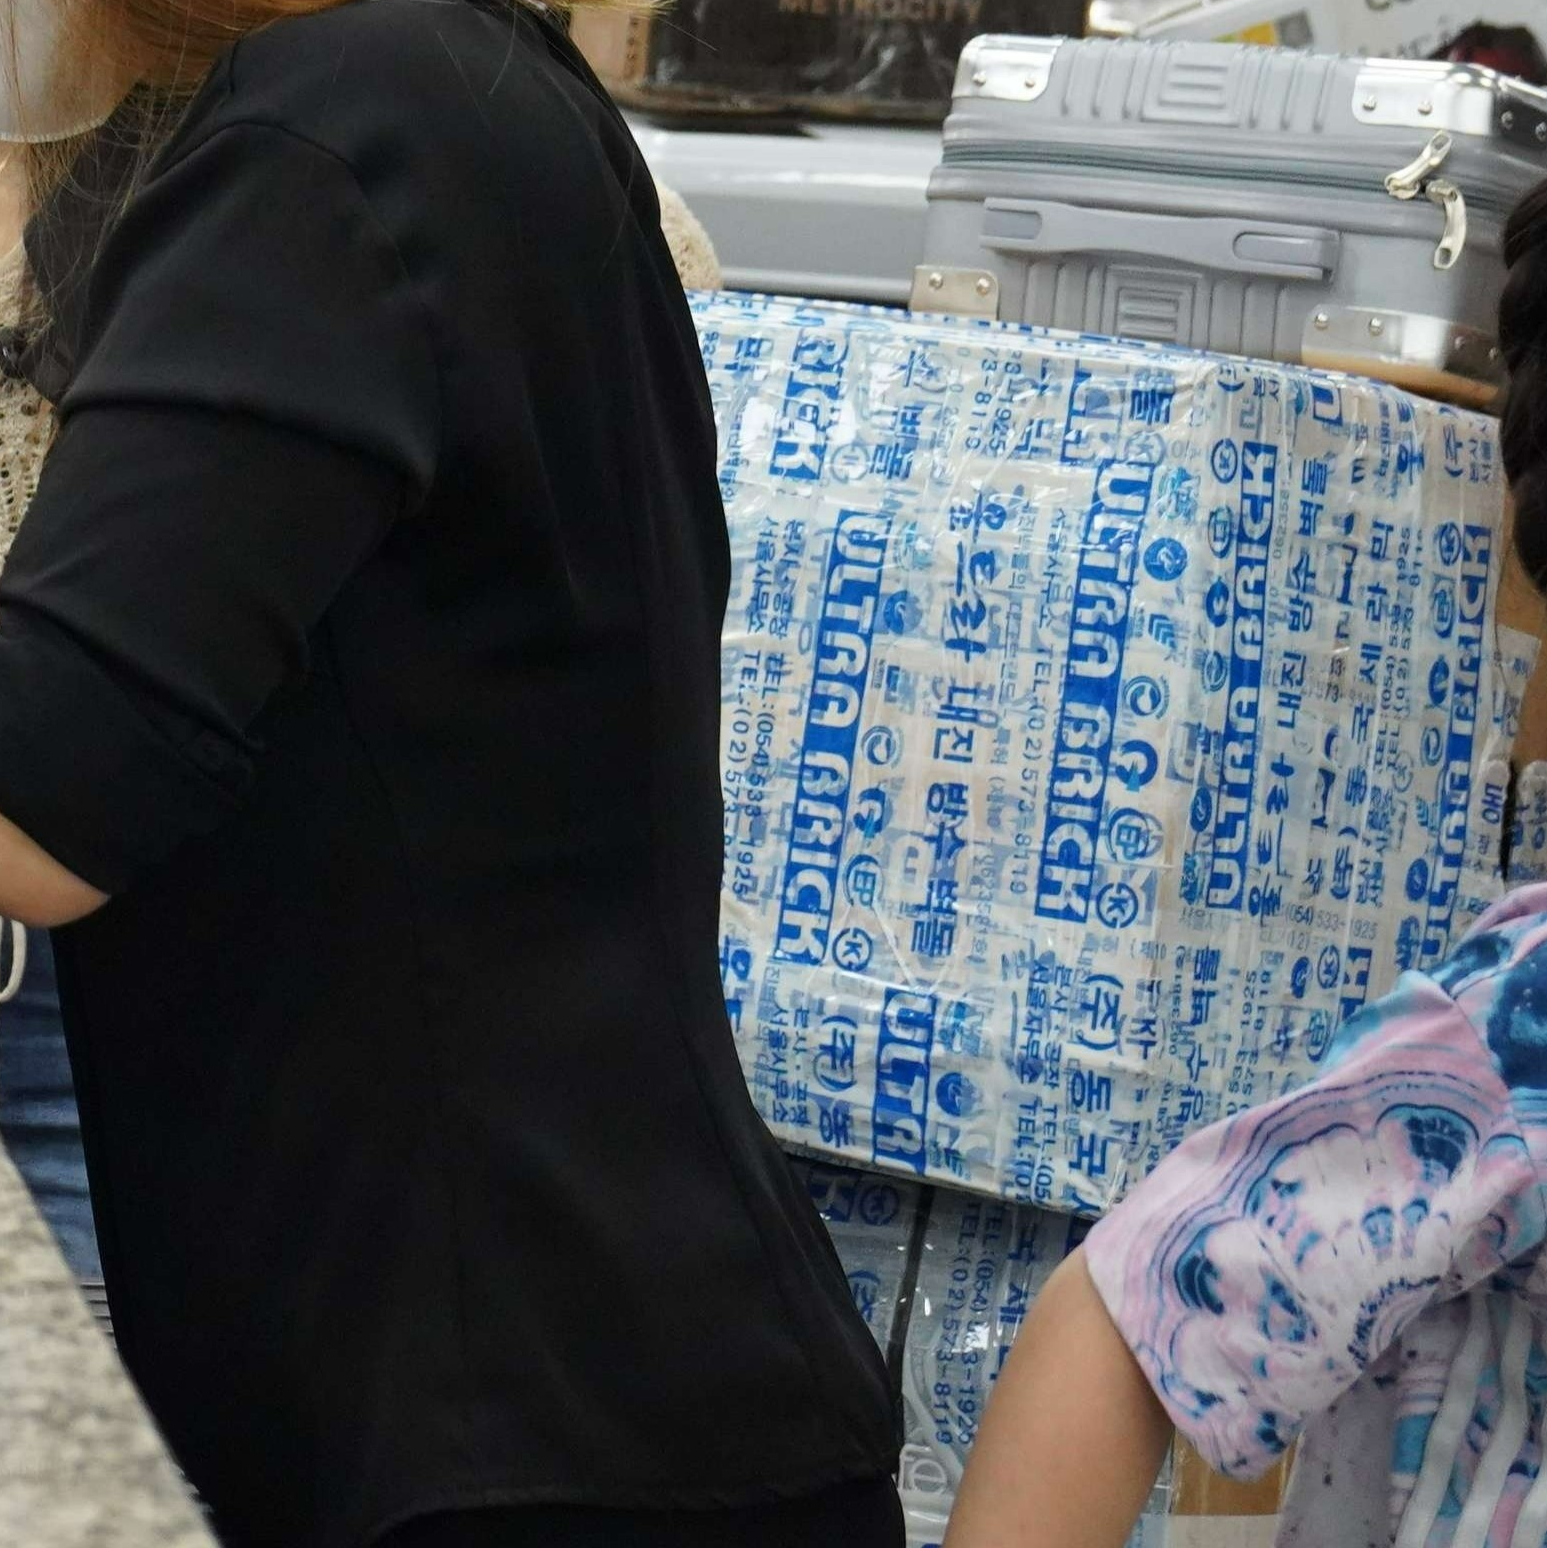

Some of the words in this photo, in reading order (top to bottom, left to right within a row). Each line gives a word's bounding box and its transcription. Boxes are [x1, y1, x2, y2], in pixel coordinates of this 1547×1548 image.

[1297, 458, 1328, 537] 벽돌
[809, 513, 882, 728] ULTRA
[1071, 466, 1152, 680] ULTRA
[1287, 551, 1317, 632] 방수
[1208, 686, 1257, 905] ULTRA
[1233, 448, 1275, 661] BRICK
[1276, 650, 1308, 731] 내진
[776, 750, 851, 959] BRICK
[922, 782, 971, 861] 방수
[1038, 704, 1112, 918] BRICK
[911, 877, 960, 958] 벽돌
